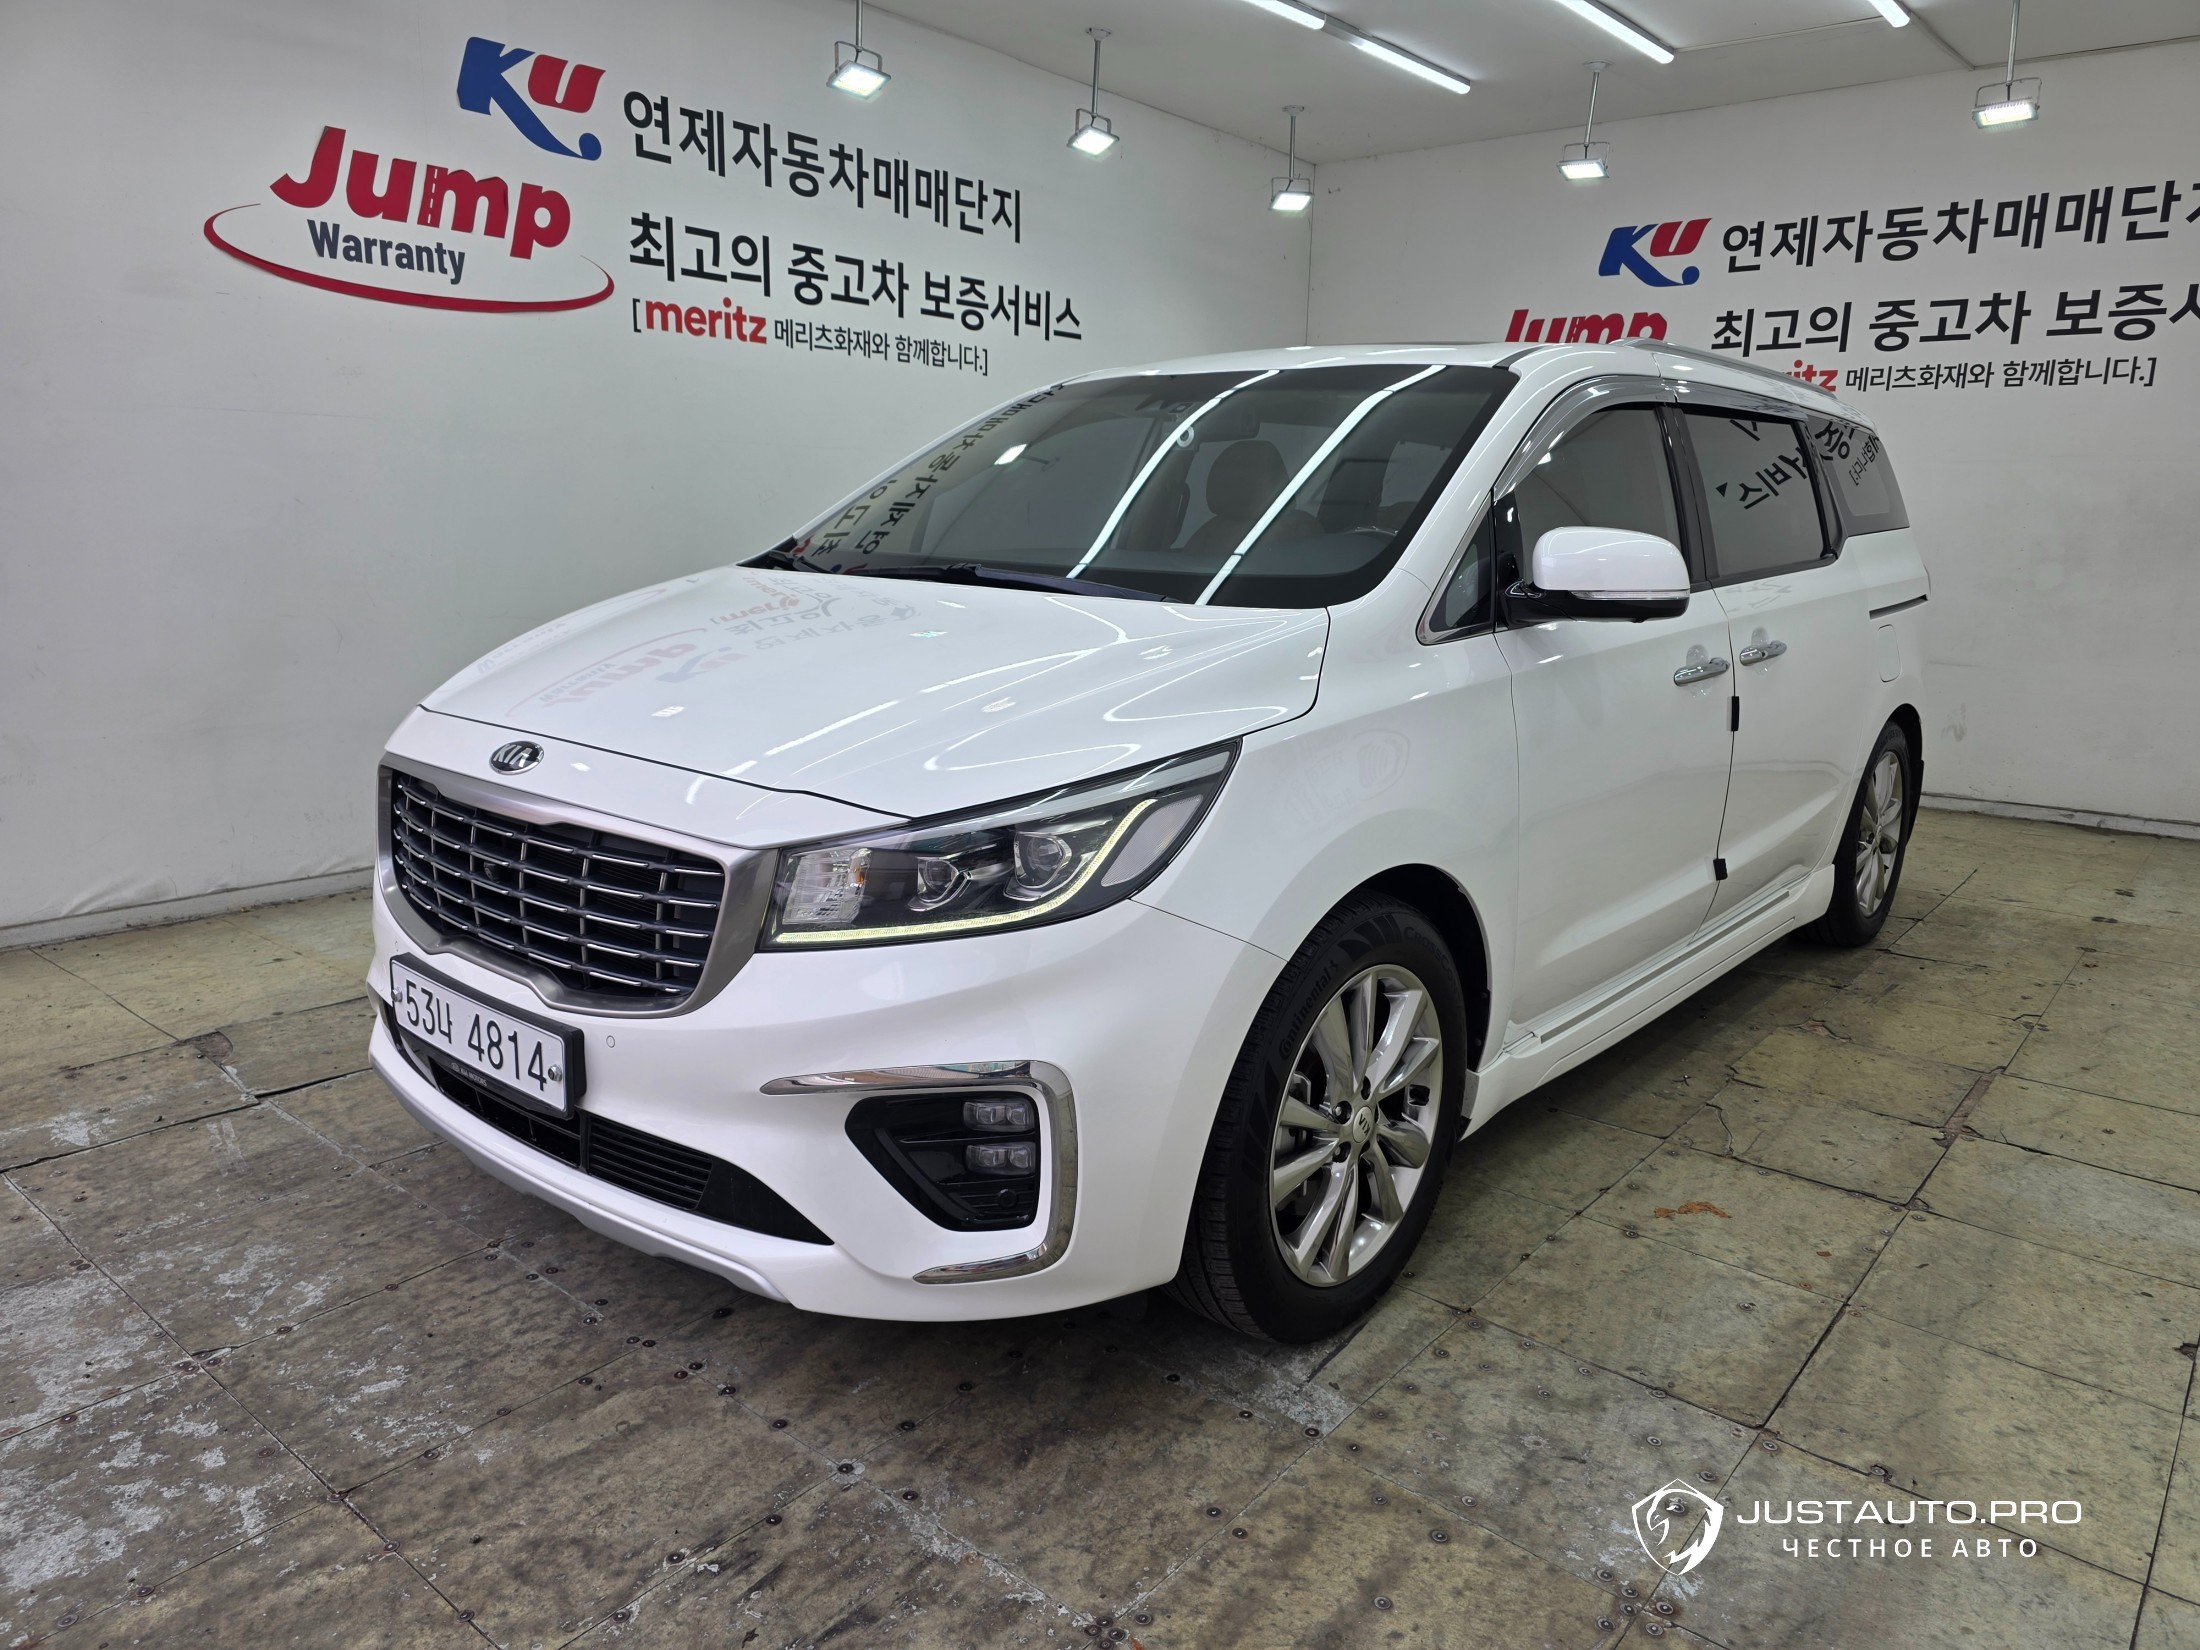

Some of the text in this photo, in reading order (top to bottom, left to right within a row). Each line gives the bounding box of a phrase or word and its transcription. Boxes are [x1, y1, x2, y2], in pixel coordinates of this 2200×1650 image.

[269, 125, 571, 260] Jump
[623, 90, 1022, 243] 연제자동차매매단지
[306, 218, 466, 286] Warranty
[629, 211, 1083, 341] 최고의 중고차 보증서비스
[774, 319, 890, 361] 메리츠화재와
[895, 334, 989, 376] 함께합니다.]
[1711, 302, 1853, 357] 최고의
[1869, 290, 2032, 352] 중고차
[1845, 361, 1995, 392] 메리츠화재와
[2002, 355, 2158, 387] 함께합니다.]
[492, 742, 534, 769] KIA
[405, 978, 548, 1092] 53나 4814
[1279, 966, 1332, 1061] Continental
